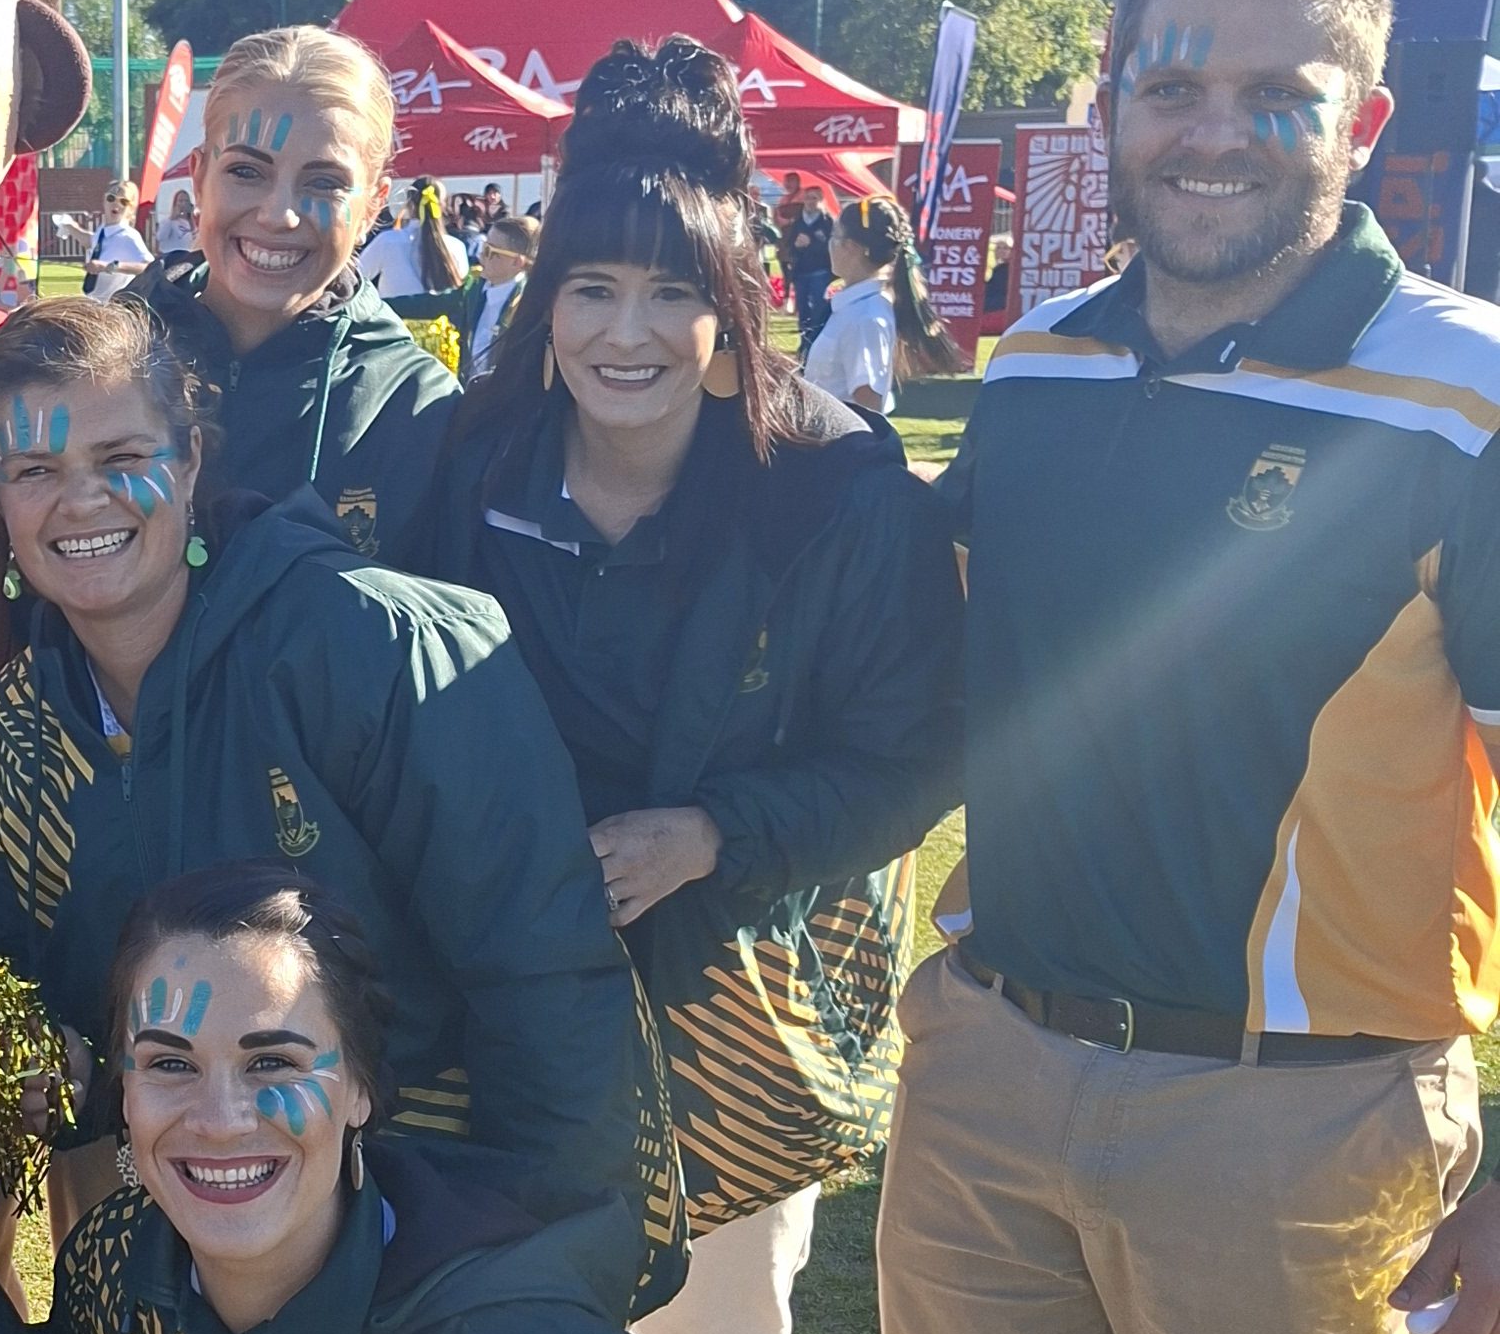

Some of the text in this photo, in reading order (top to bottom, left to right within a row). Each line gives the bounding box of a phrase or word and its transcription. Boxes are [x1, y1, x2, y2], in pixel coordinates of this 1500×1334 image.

[937, 227, 983, 240] ONERY
[933, 245, 981, 265] TS &
